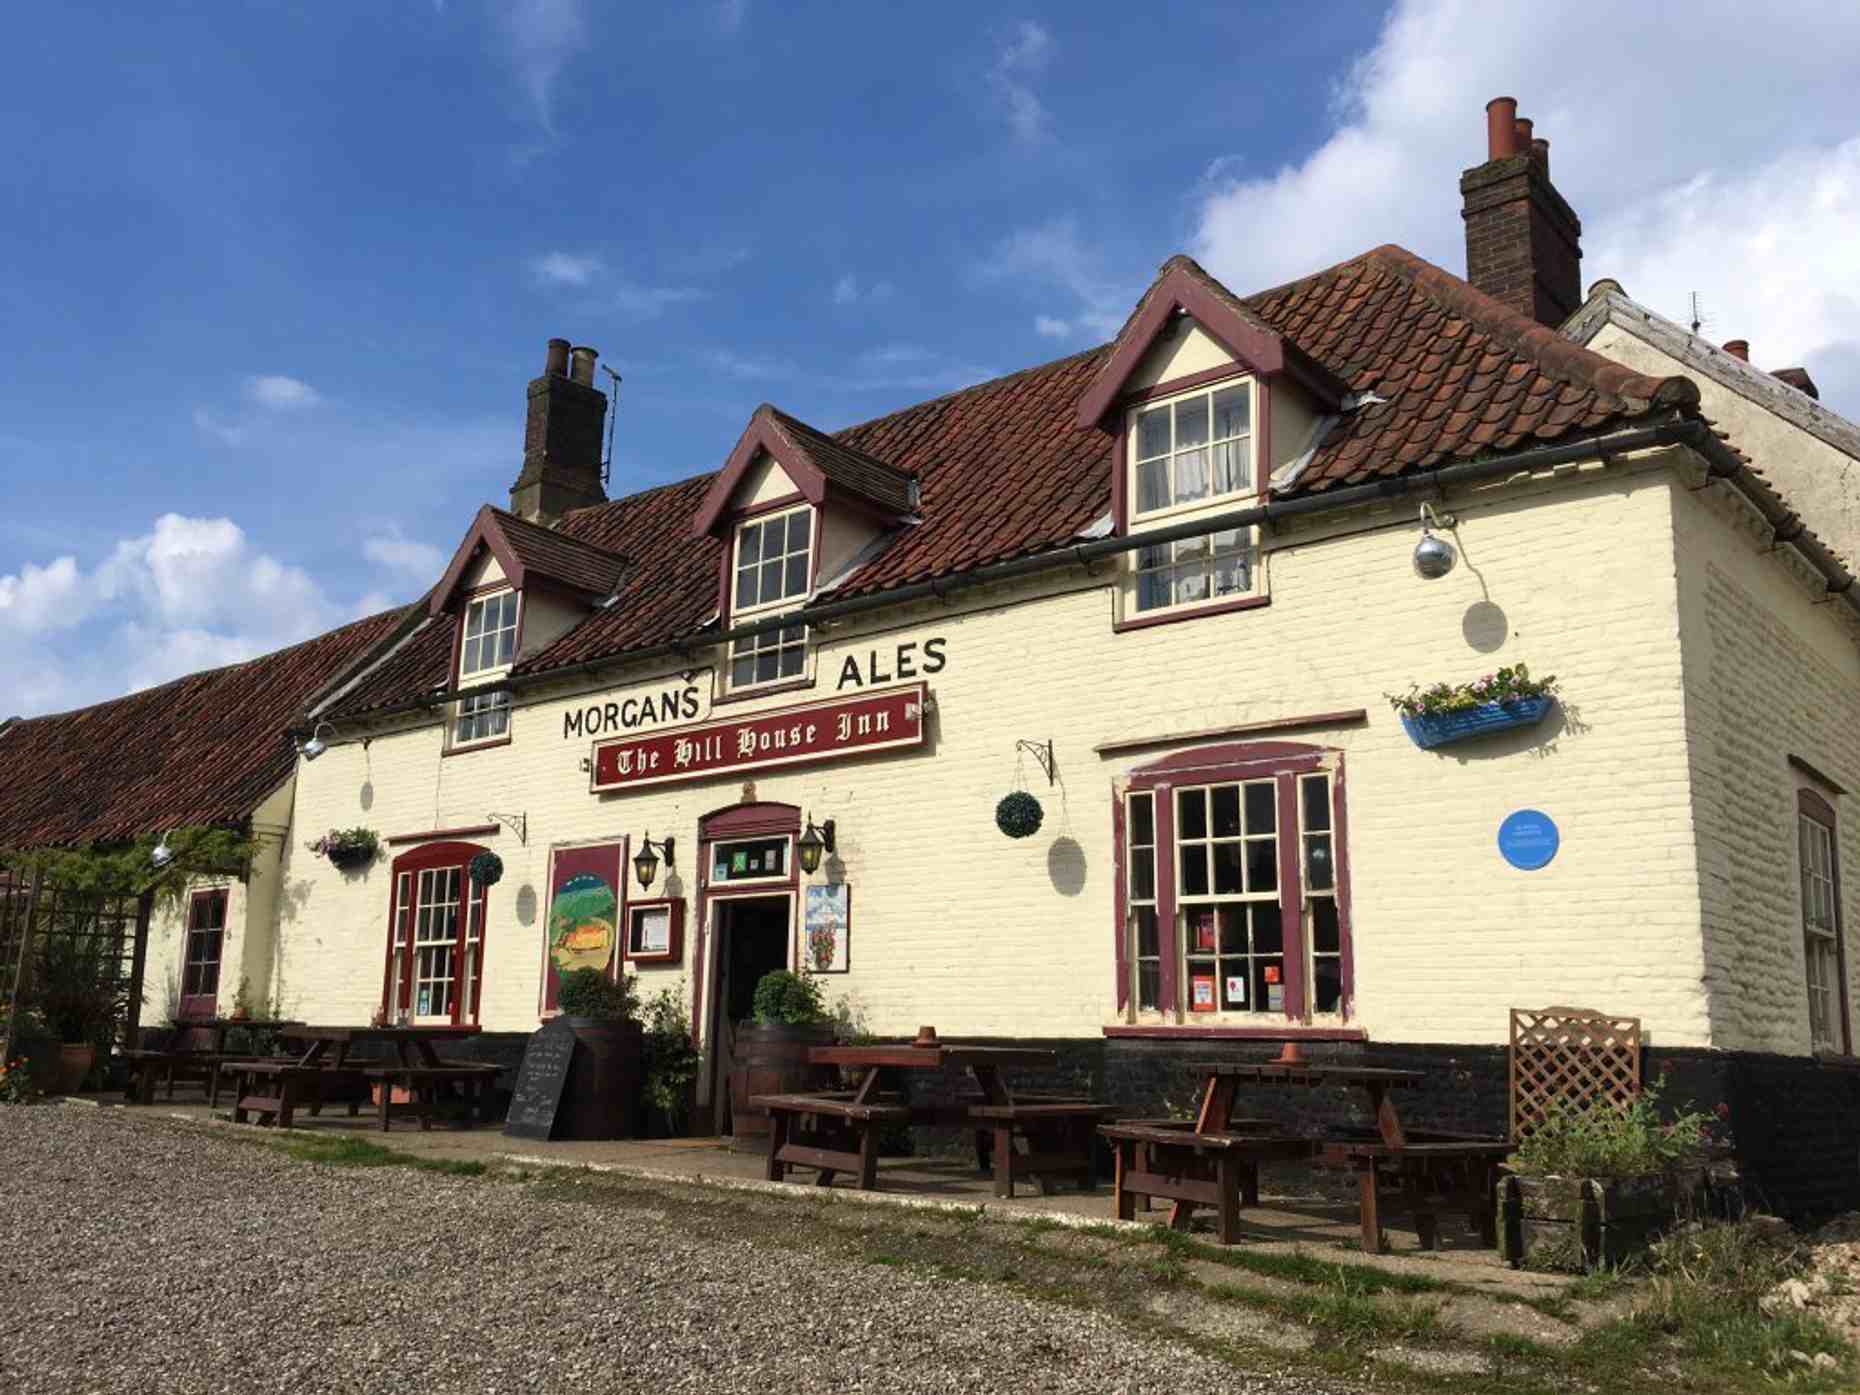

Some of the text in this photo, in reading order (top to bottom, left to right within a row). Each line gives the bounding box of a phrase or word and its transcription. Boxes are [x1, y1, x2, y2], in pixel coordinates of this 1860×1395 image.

[563, 638, 948, 740] MORGANS ALES
[616, 709, 890, 774] The Hill House Inn
